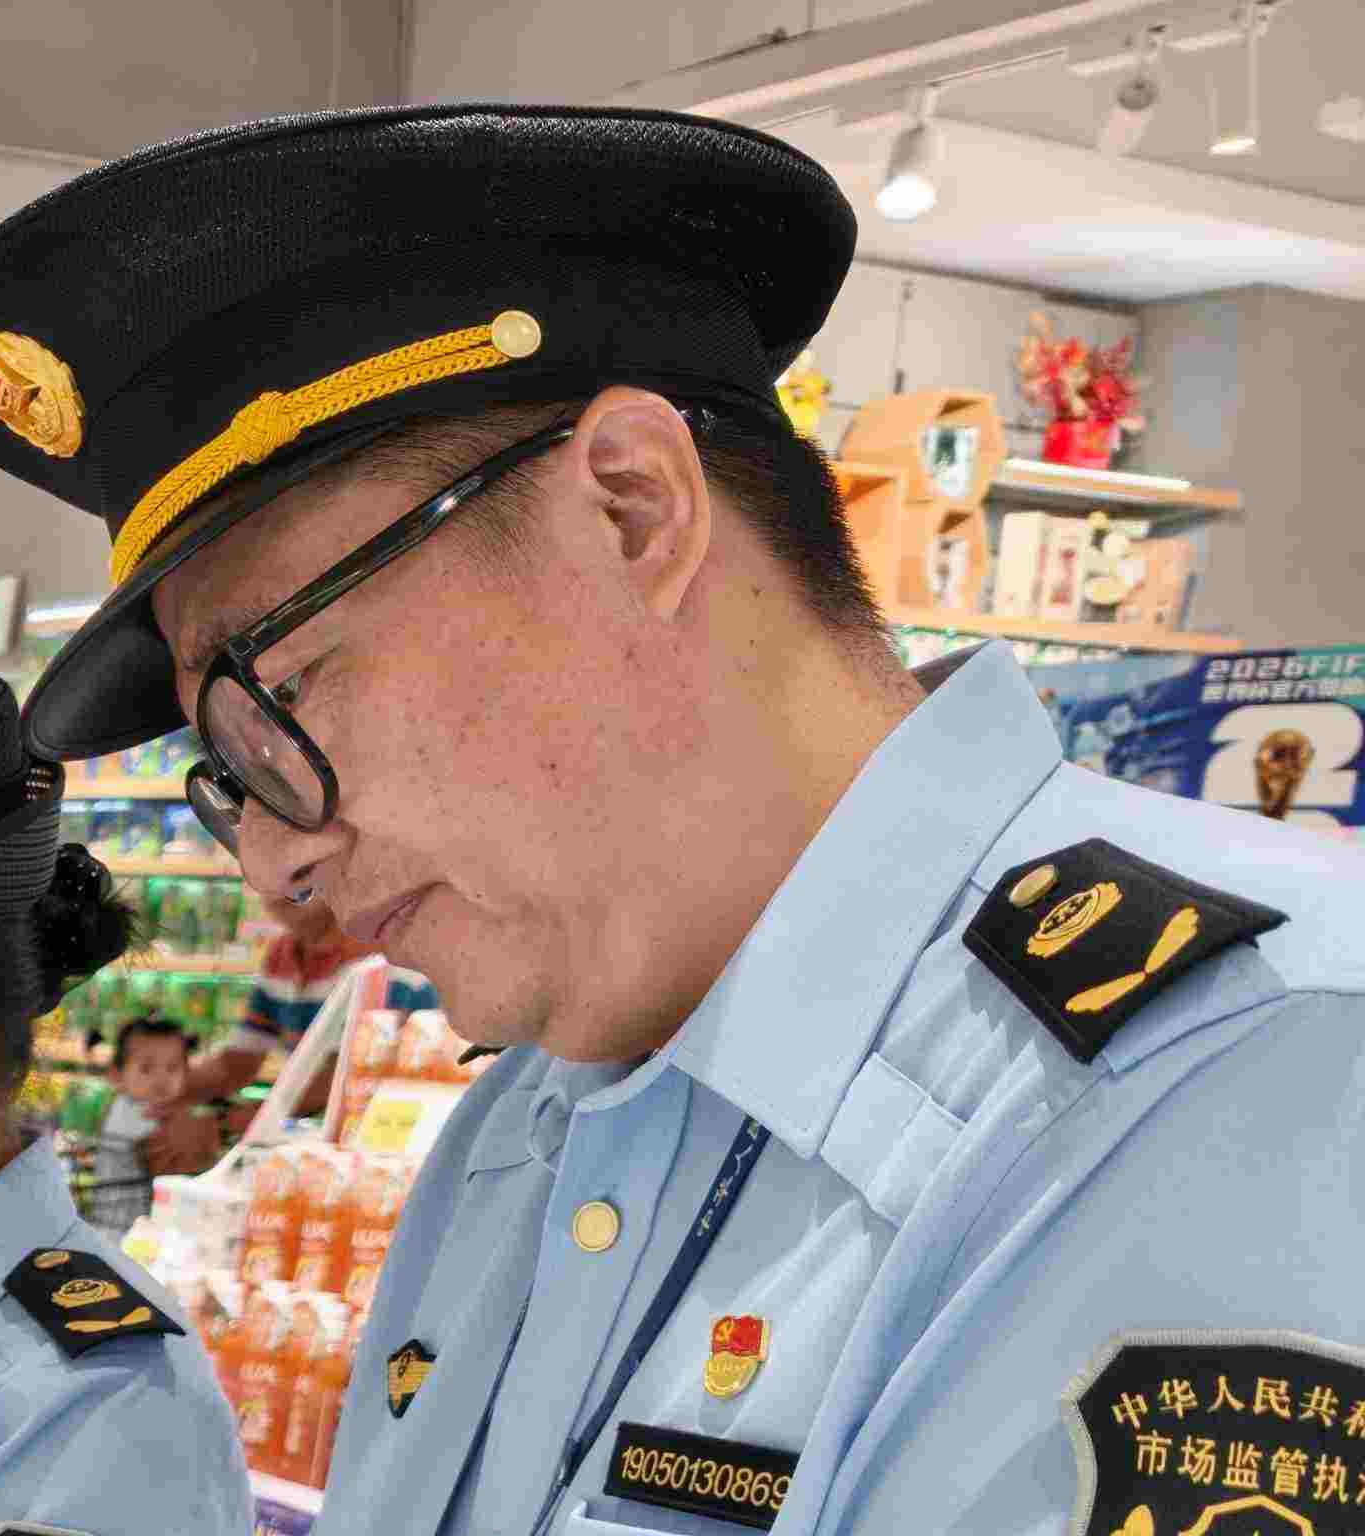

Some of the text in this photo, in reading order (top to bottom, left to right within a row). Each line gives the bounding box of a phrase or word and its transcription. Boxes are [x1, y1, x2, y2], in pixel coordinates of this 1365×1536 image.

[621, 1445, 791, 1510] 19050130869
[1136, 1430, 1365, 1504] 市场监管执
